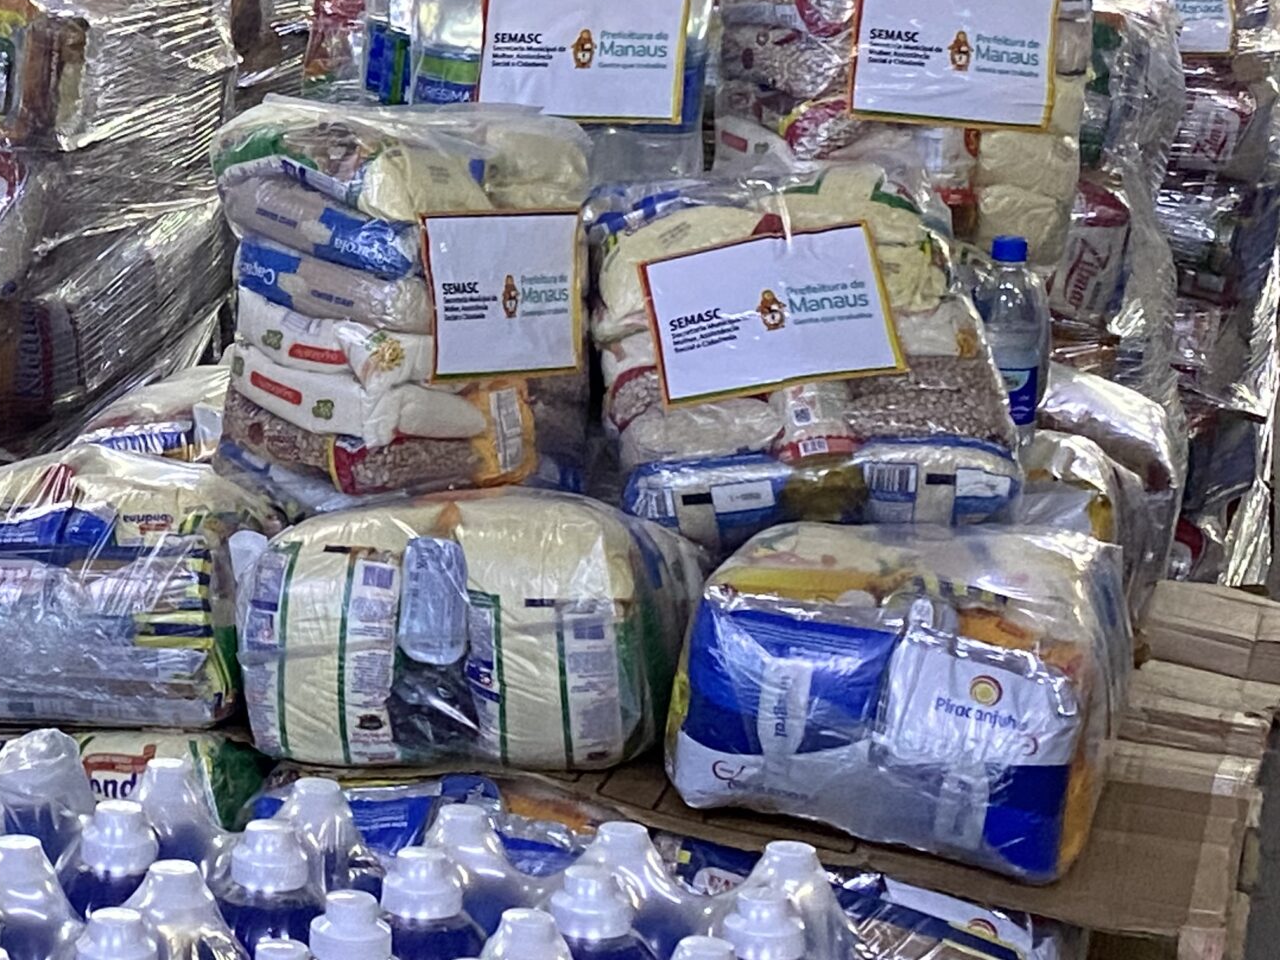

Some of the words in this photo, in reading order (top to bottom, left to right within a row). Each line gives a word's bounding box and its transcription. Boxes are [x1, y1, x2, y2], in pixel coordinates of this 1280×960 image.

[493, 32, 543, 44] SEMASC
[600, 30, 654, 40] Prefeitura
[870, 28, 920, 43] SEMASC
[976, 34, 1026, 47] Prefeitura
[599, 41, 668, 58] Manaus
[976, 44, 1039, 66] Manaus
[1063, 239, 1110, 312] Zilmar
[442, 281, 480, 295] SEMASC
[521, 287, 569, 304] Manaus
[786, 282, 848, 297] Prefeitura
[850, 280, 865, 289] de
[788, 293, 869, 313] Manaus
[669, 308, 723, 331] SEMASC
